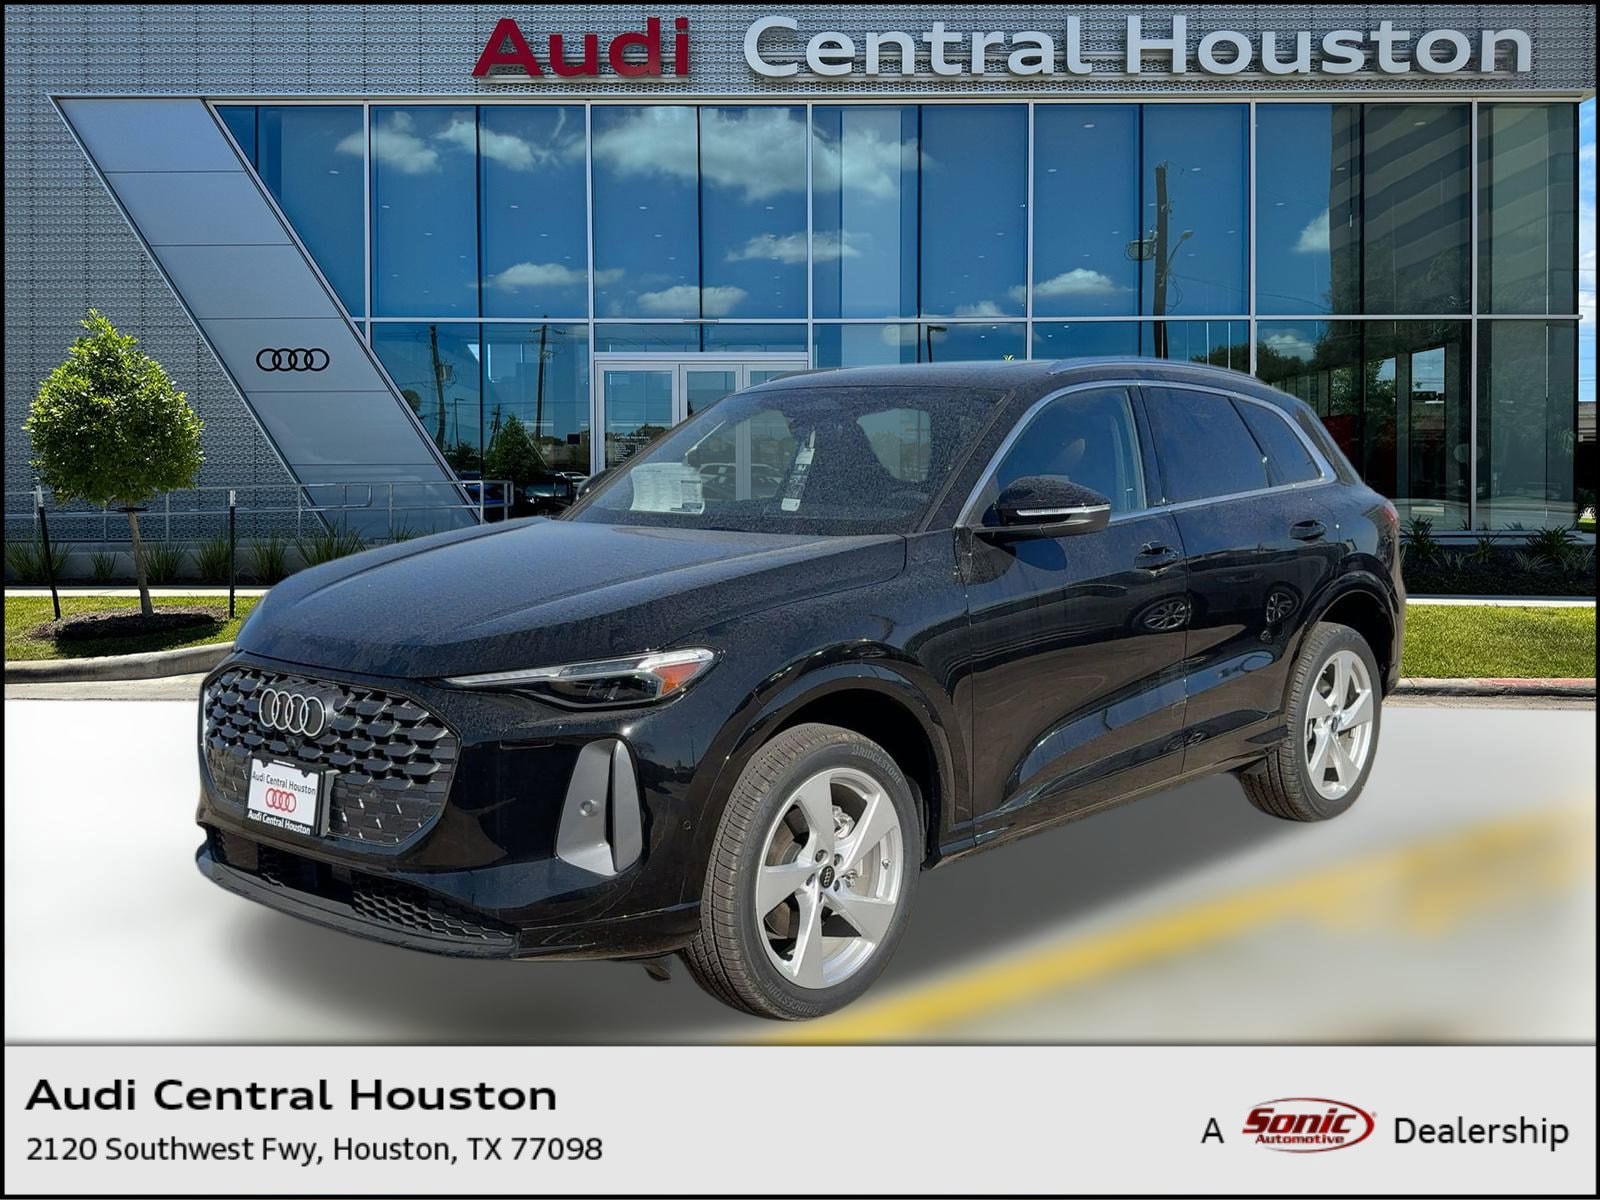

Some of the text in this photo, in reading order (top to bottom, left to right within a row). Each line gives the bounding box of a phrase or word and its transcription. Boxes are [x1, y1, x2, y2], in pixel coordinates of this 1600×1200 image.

[472, 15, 1532, 78] Audi Central Houston
[252, 771, 316, 795] Audi Central Houston
[248, 810, 311, 835] Audi Central Houston
